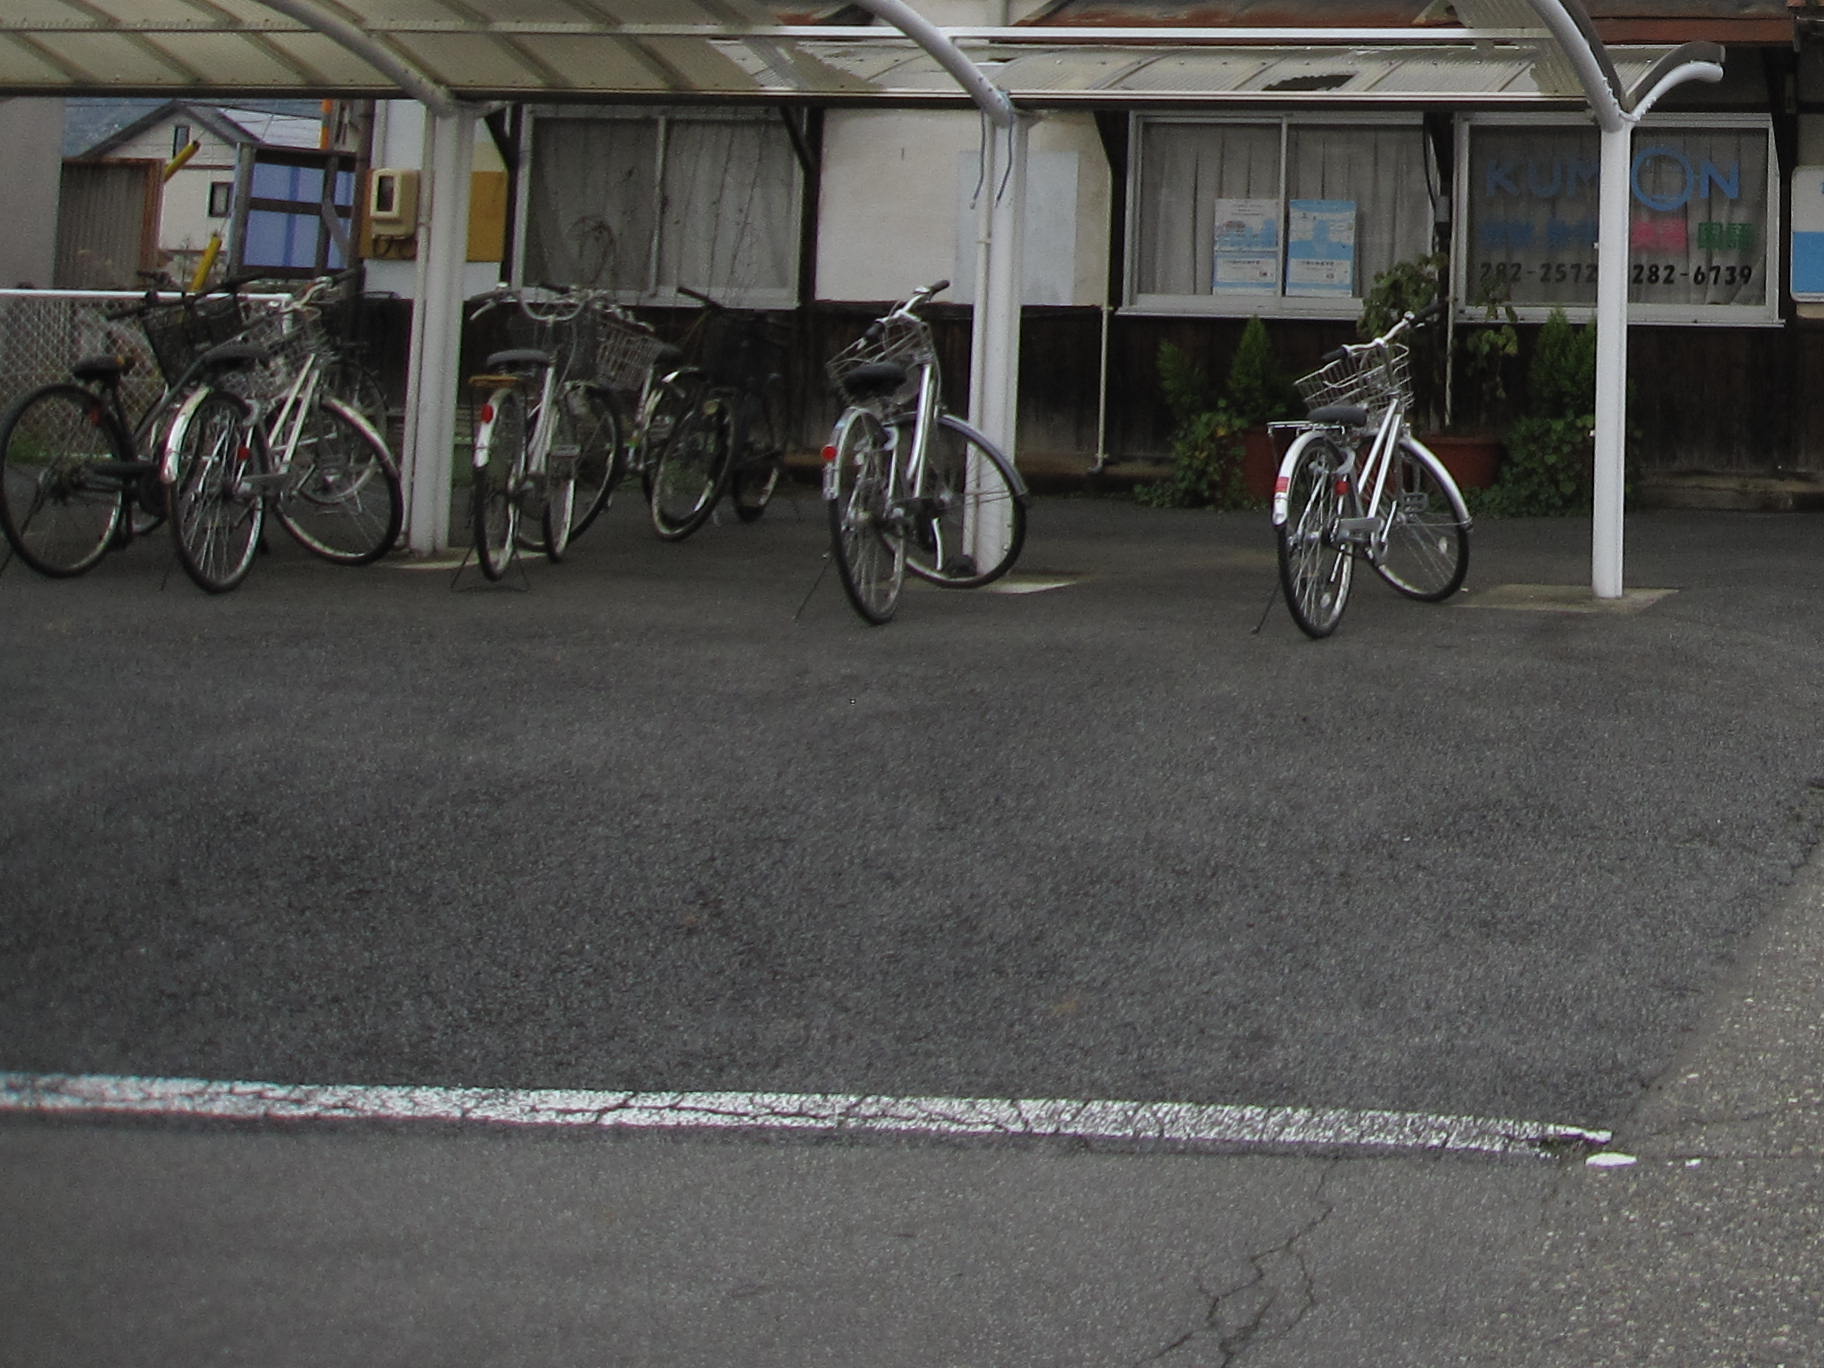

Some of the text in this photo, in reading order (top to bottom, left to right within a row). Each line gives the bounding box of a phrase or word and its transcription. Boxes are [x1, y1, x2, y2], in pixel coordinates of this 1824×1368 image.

[1485, 146, 1740, 212] KUMON
[1479, 262, 1753, 285] 282-2572 282-6739
